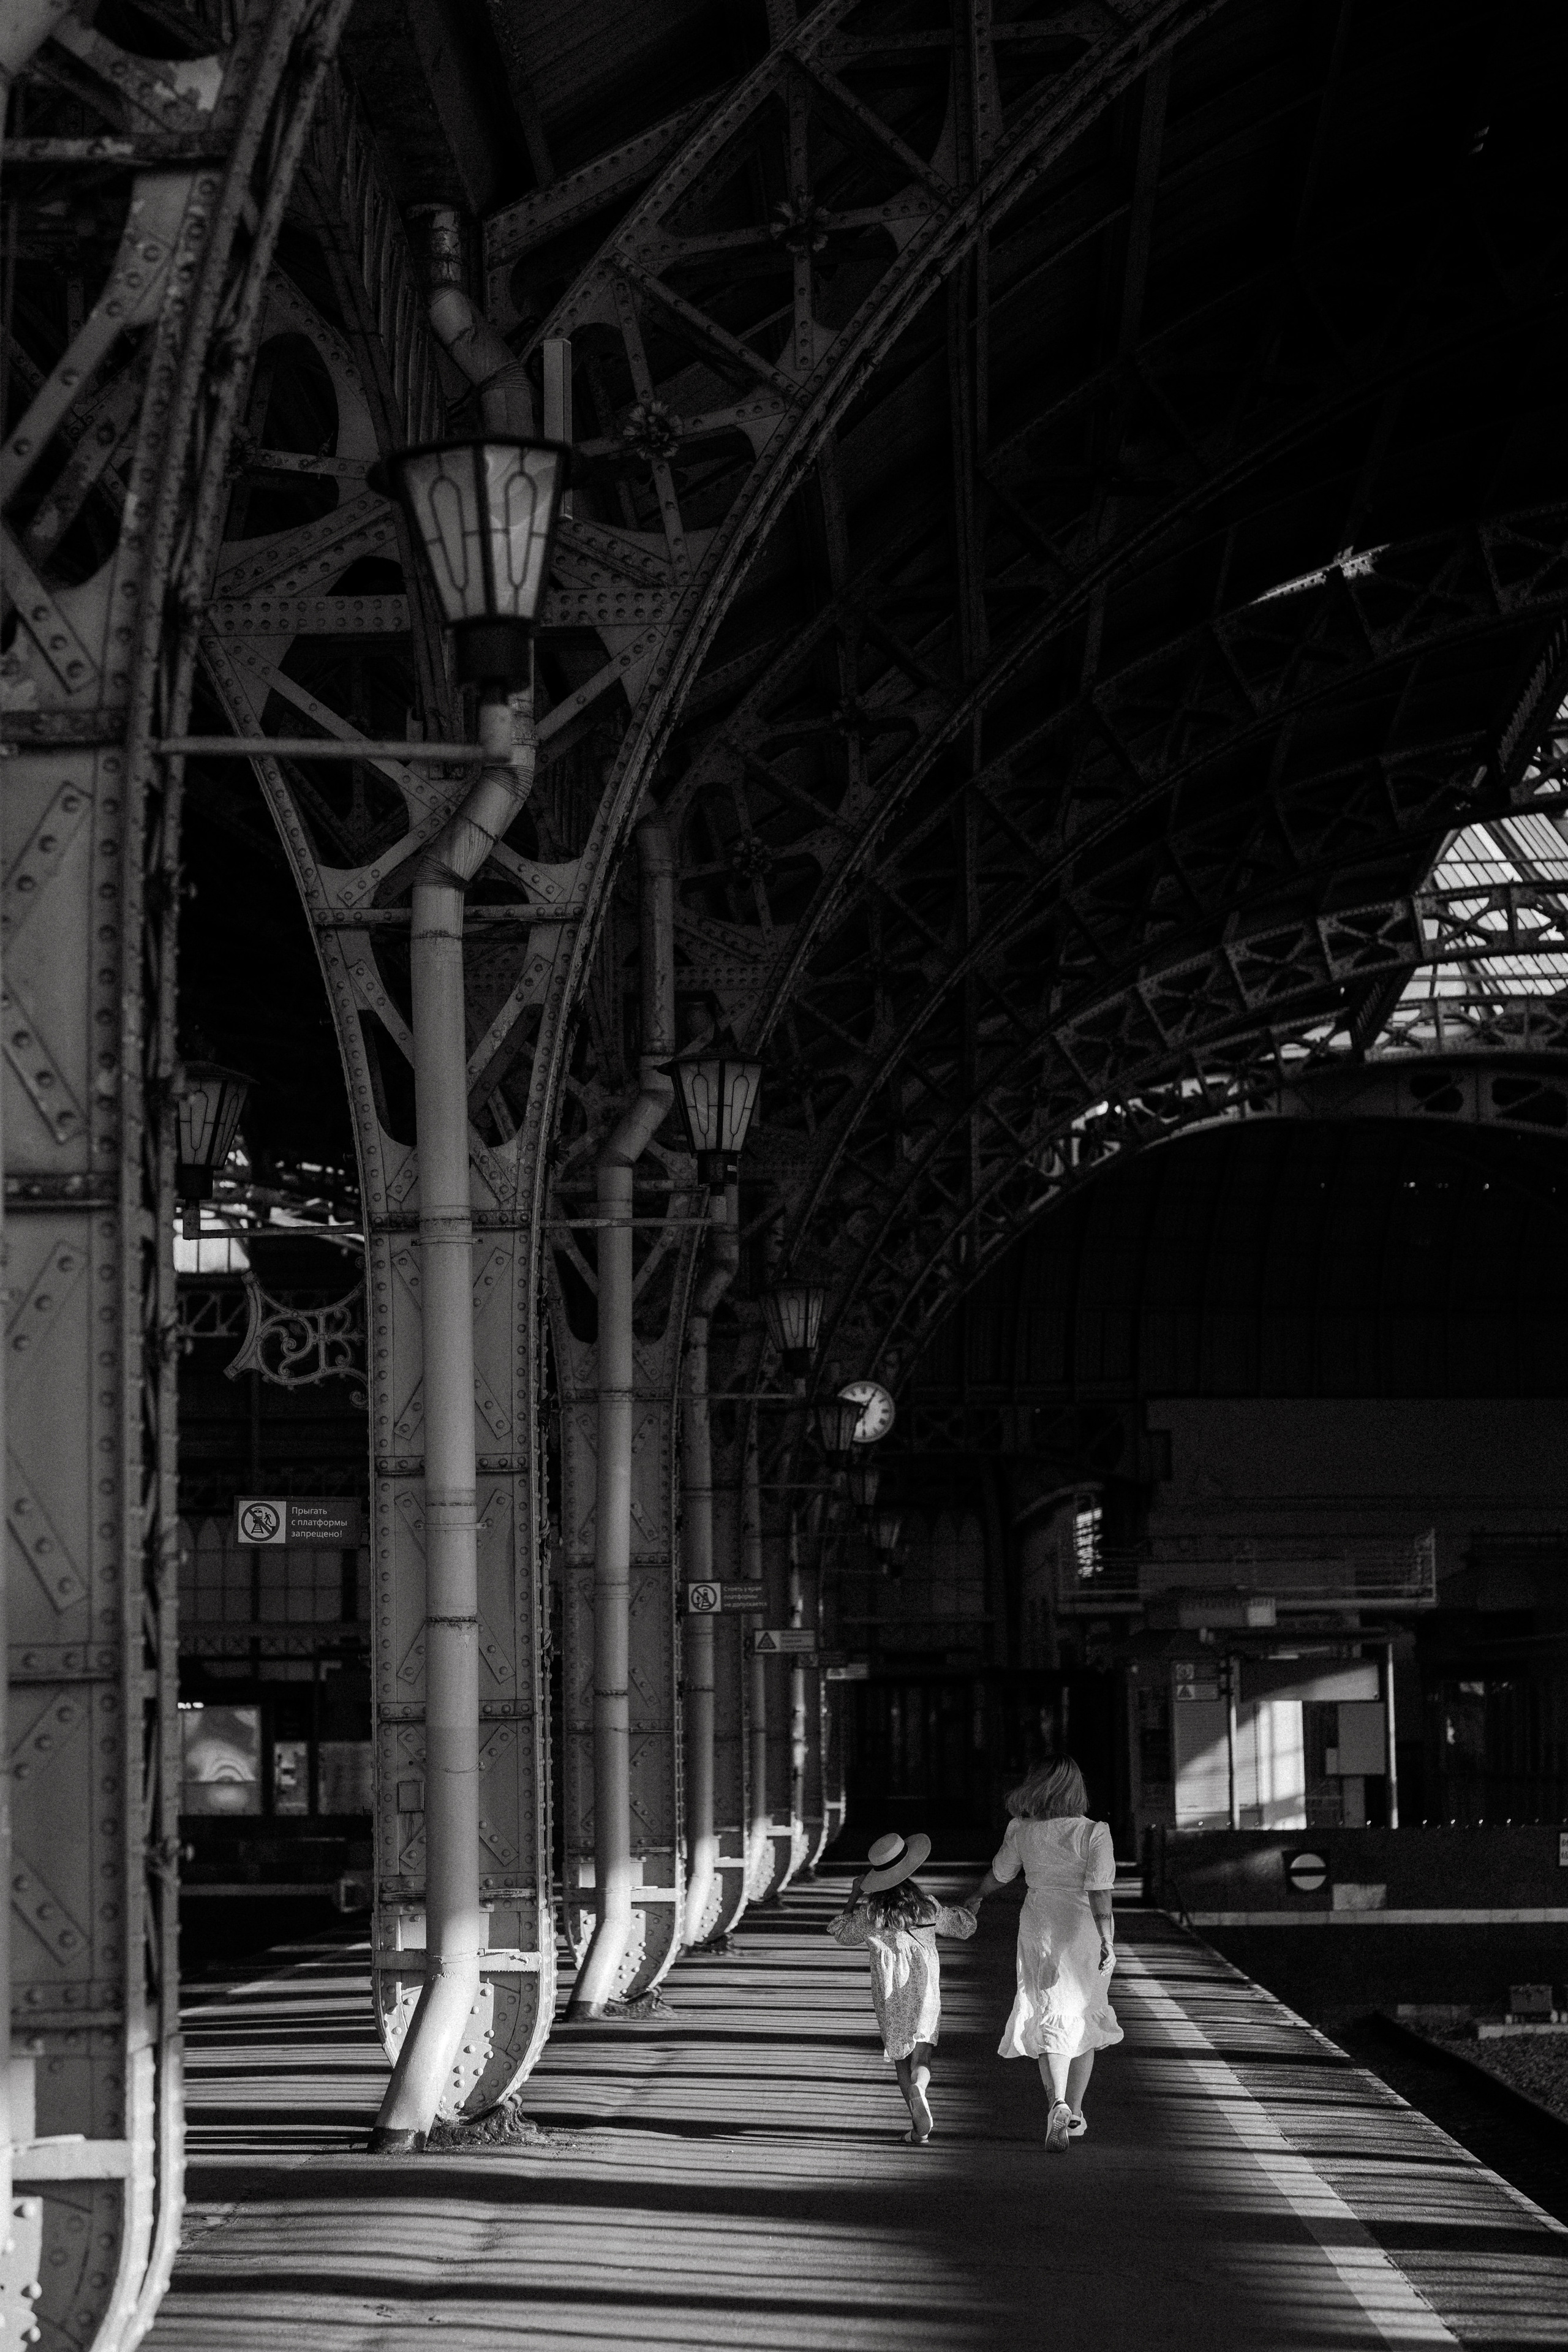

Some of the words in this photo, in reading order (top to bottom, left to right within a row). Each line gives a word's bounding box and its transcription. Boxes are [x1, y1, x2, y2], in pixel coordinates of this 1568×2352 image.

[292, 1507, 327, 1516] Прыгать
[298, 1518, 347, 1528] платформы
[291, 1530, 342, 1539] запрещено!
